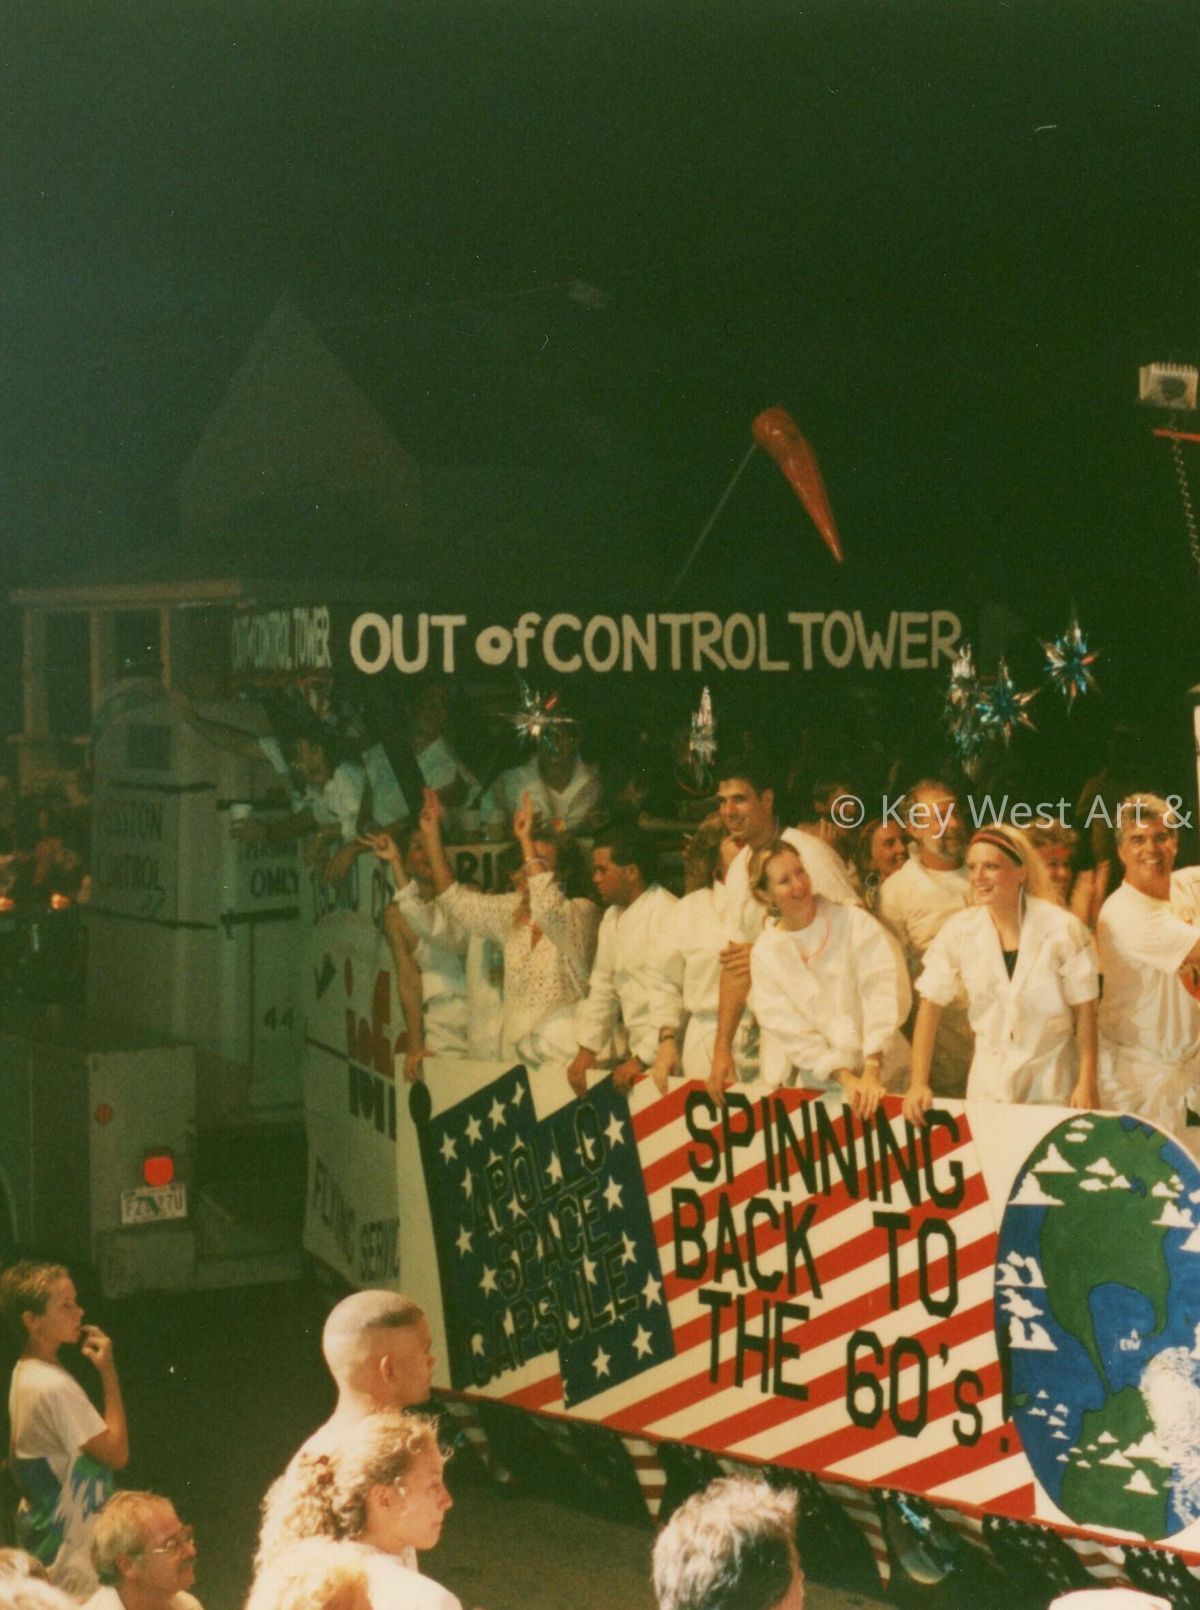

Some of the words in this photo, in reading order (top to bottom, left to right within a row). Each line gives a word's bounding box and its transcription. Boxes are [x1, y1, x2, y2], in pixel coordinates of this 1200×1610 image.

[350, 612, 467, 673] OUT
[475, 611, 541, 666] of
[542, 611, 790, 673] CONTROL
[788, 610, 964, 670] TOWER
[470, 1102, 607, 1238] APOLLO
[684, 1090, 966, 1210] SPINNING
[493, 1174, 611, 1300] SPACE
[671, 1187, 823, 1299] BACK
[873, 1211, 959, 1318] TO
[467, 1240, 640, 1389] CAPSULE
[698, 1288, 810, 1401] THE
